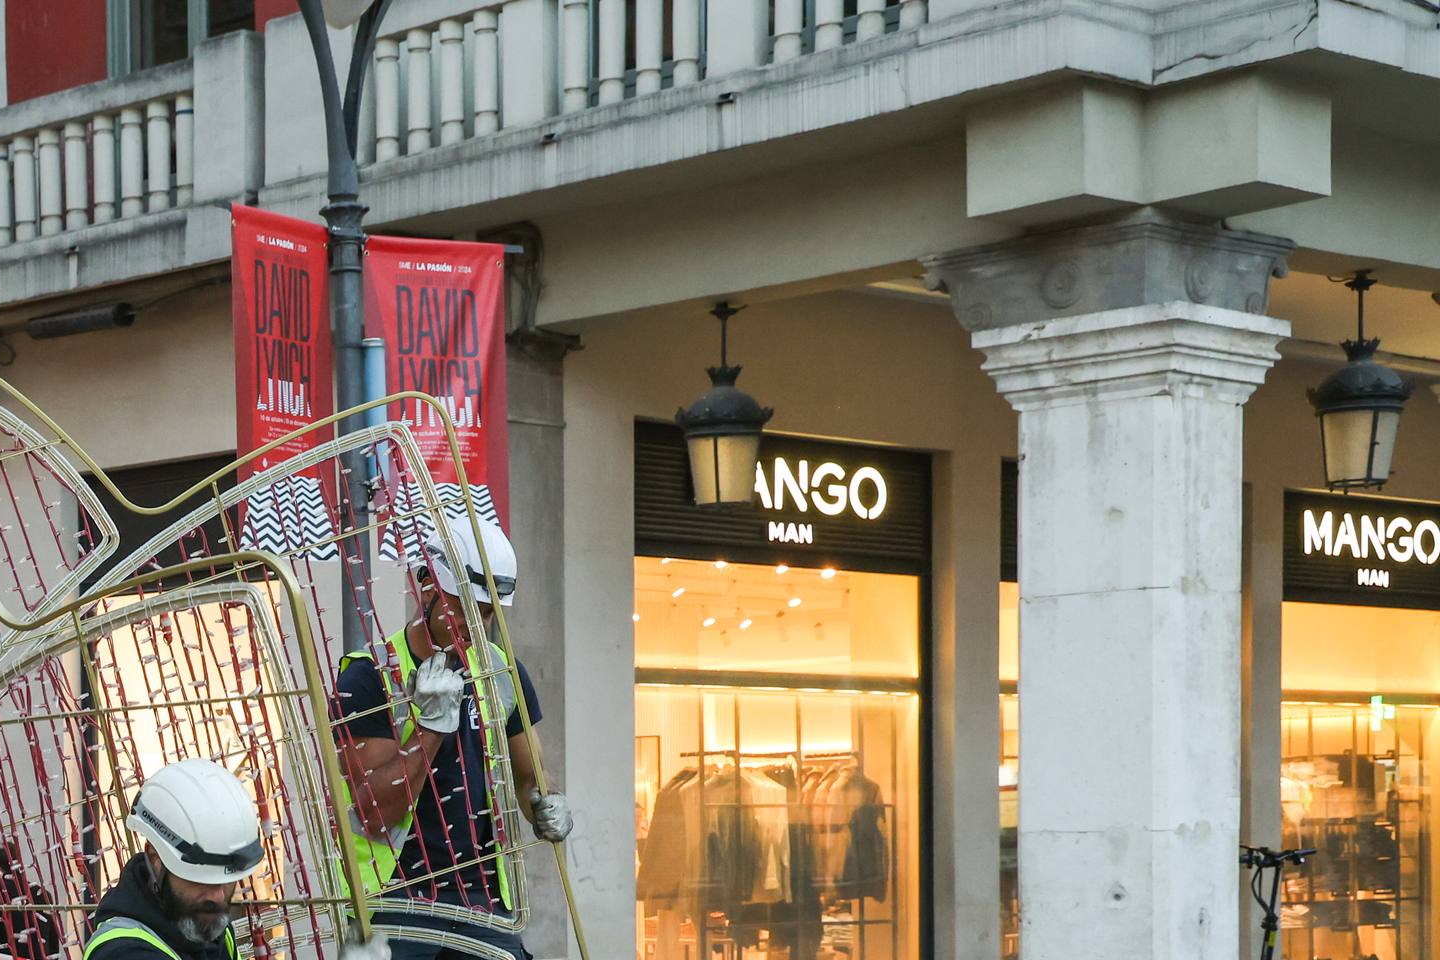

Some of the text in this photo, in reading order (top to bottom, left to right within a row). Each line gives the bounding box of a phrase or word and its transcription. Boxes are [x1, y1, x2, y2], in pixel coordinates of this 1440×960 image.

[255, 260, 310, 342] DAVID
[396, 285, 479, 358] DAVID
[256, 336, 312, 417] LYNCH
[399, 357, 482, 429] LYNCH
[754, 457, 887, 520] ANGO
[768, 521, 813, 544] MAN
[1303, 509, 1440, 565] MANGO
[1357, 567, 1389, 588] MAN
